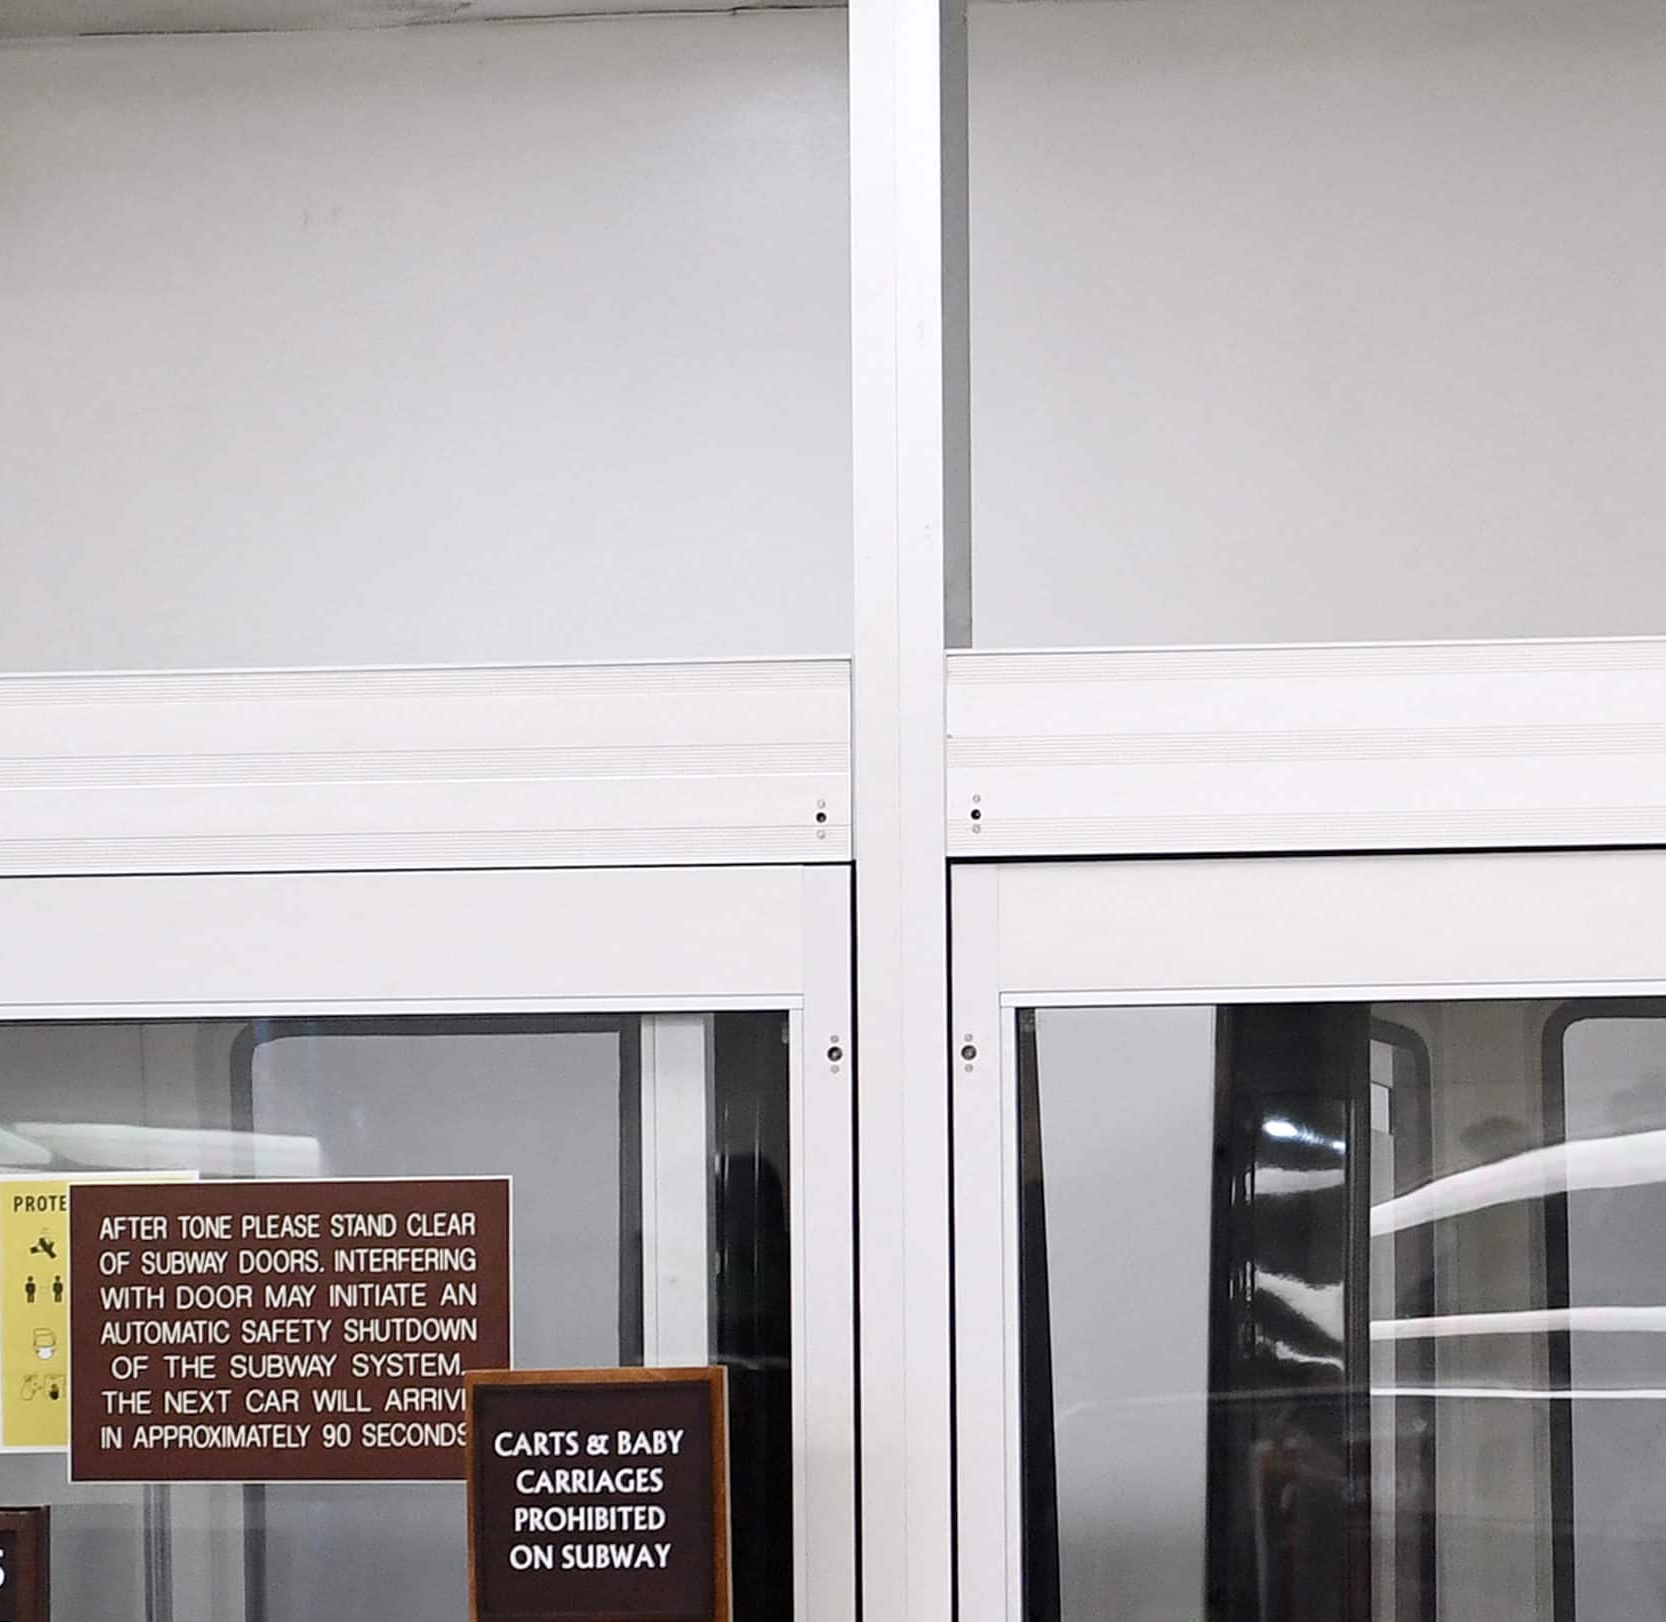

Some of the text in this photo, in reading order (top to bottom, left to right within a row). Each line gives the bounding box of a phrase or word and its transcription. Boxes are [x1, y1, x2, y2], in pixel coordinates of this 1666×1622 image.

[13, 1194, 67, 1213] PROTE
[99, 1212, 476, 1241] AFTER TONE PLEASE STAND CLEAR
[99, 1247, 477, 1275] OF SUBWAY DOORS. INTERFERING
[100, 1282, 477, 1310] WITH DOOR MAY INITIATE AN
[100, 1317, 477, 1345] AUTOMATIC SAFETY SHUTDOWN
[111, 1350, 465, 1380] OF THE SUBWAY SYSTEM.
[101, 1390, 152, 1415] THE
[164, 1389, 232, 1414] NEXT
[245, 1389, 300, 1413] CAR
[312, 1389, 372, 1413] WILL
[101, 1422, 467, 1449] IN APPROXIMATELY 90 SECONDS
[494, 1429, 684, 1457] CARTS & BABY
[516, 1467, 664, 1494] CARRIAGES
[515, 1505, 666, 1532] PROHIBITED
[509, 1543, 671, 1570] ON SUBWAY
